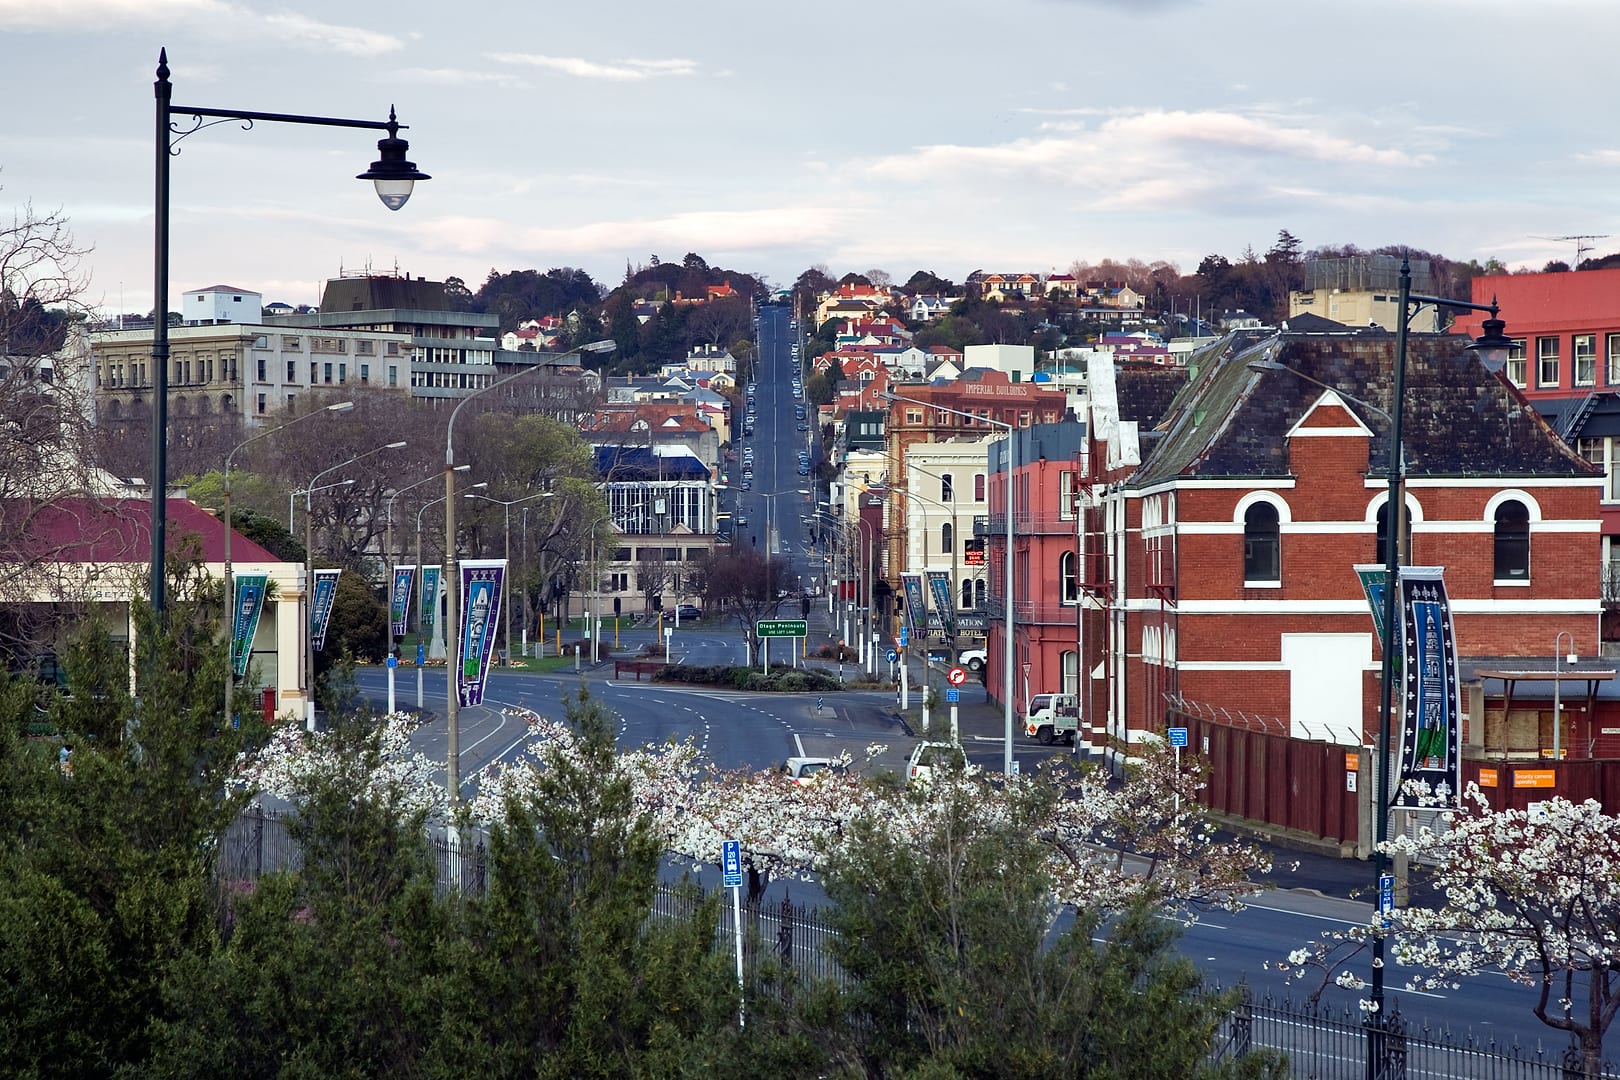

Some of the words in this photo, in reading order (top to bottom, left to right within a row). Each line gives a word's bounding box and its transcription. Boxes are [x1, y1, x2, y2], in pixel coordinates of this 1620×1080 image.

[965, 384, 994, 395] IMPERIAL
[996, 385, 1028, 396] BUILDINGS
[728, 842, 734, 851] P
[1384, 878, 1390, 888] P
